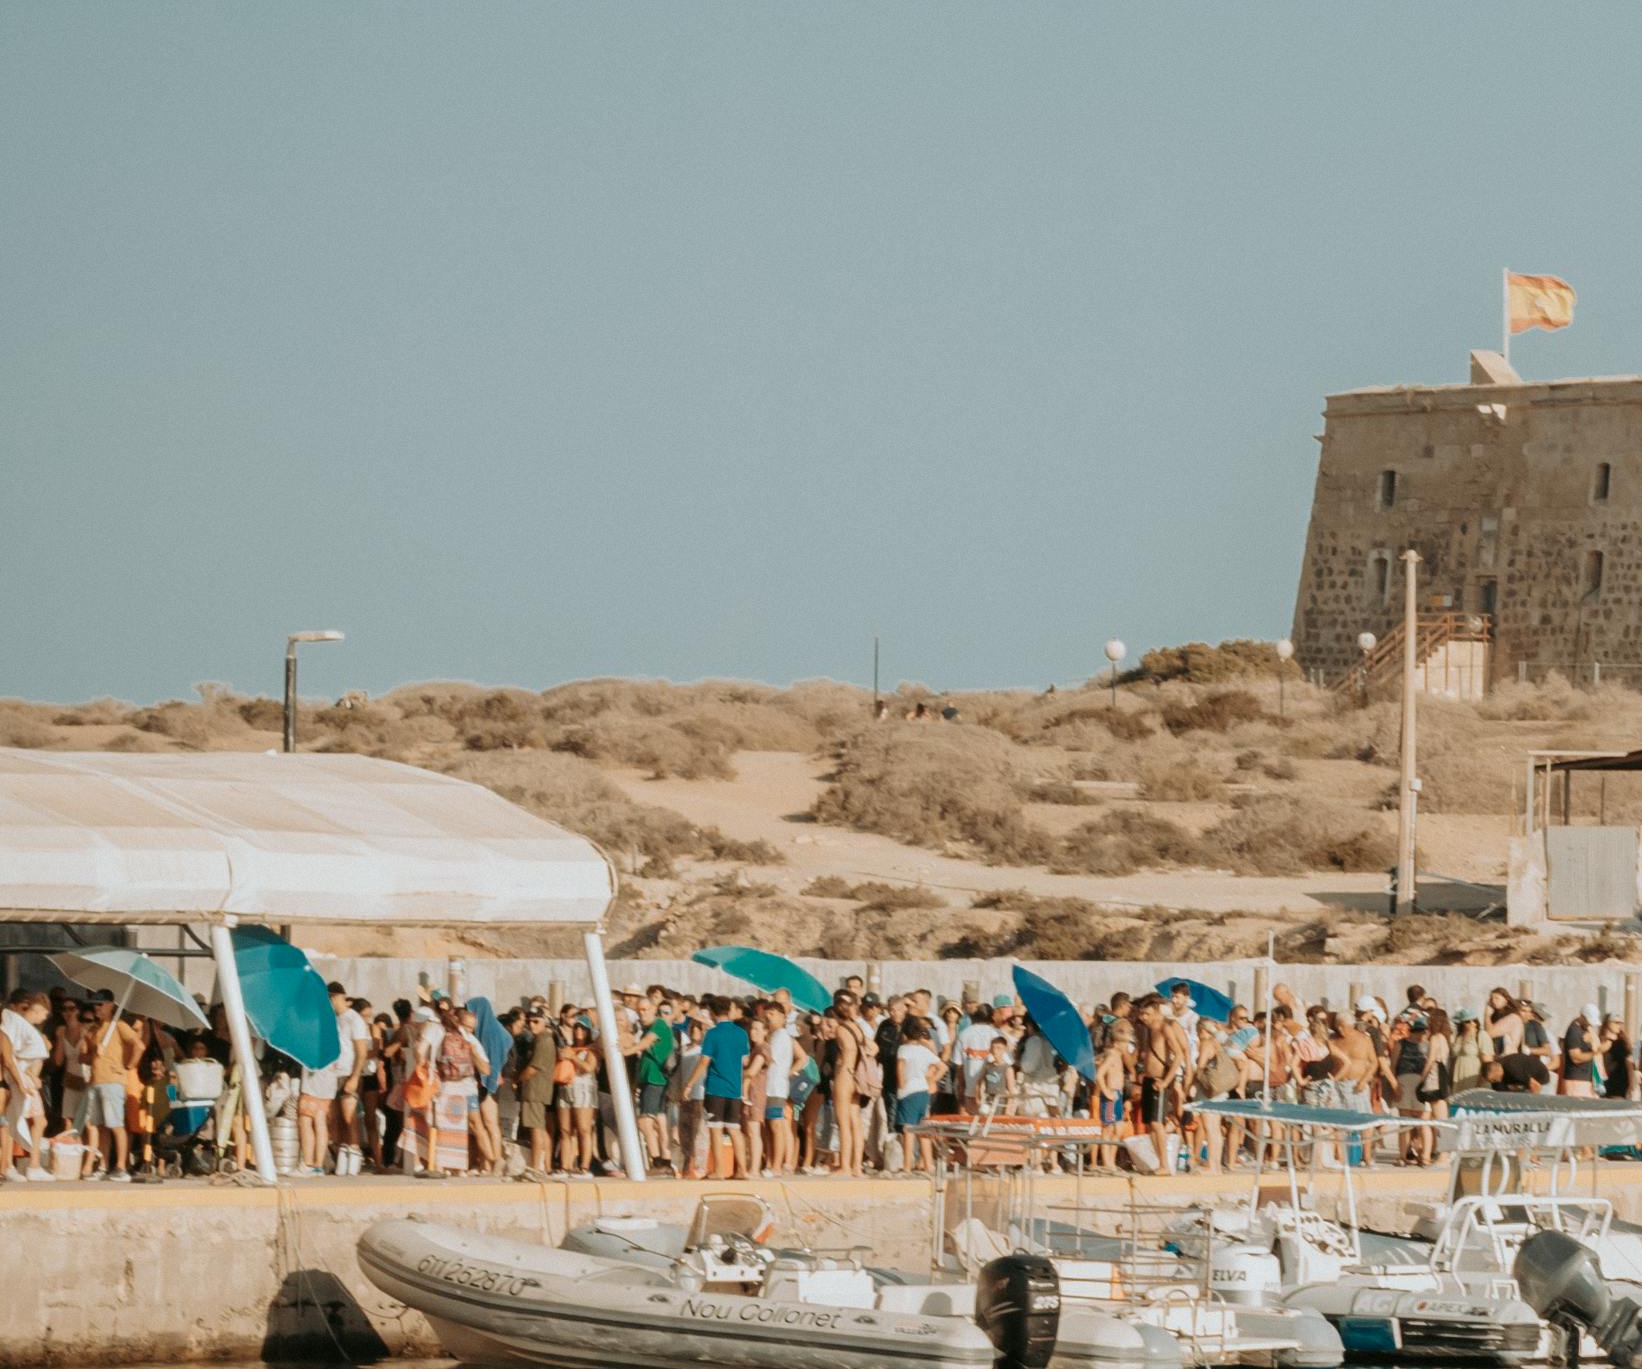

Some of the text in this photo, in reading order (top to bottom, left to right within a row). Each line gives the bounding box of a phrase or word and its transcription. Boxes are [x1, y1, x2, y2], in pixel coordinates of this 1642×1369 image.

[1492, 1121, 1551, 1135] MURALLA
[417, 1253, 524, 1296] 611252870
[679, 1298, 732, 1320] Nou
